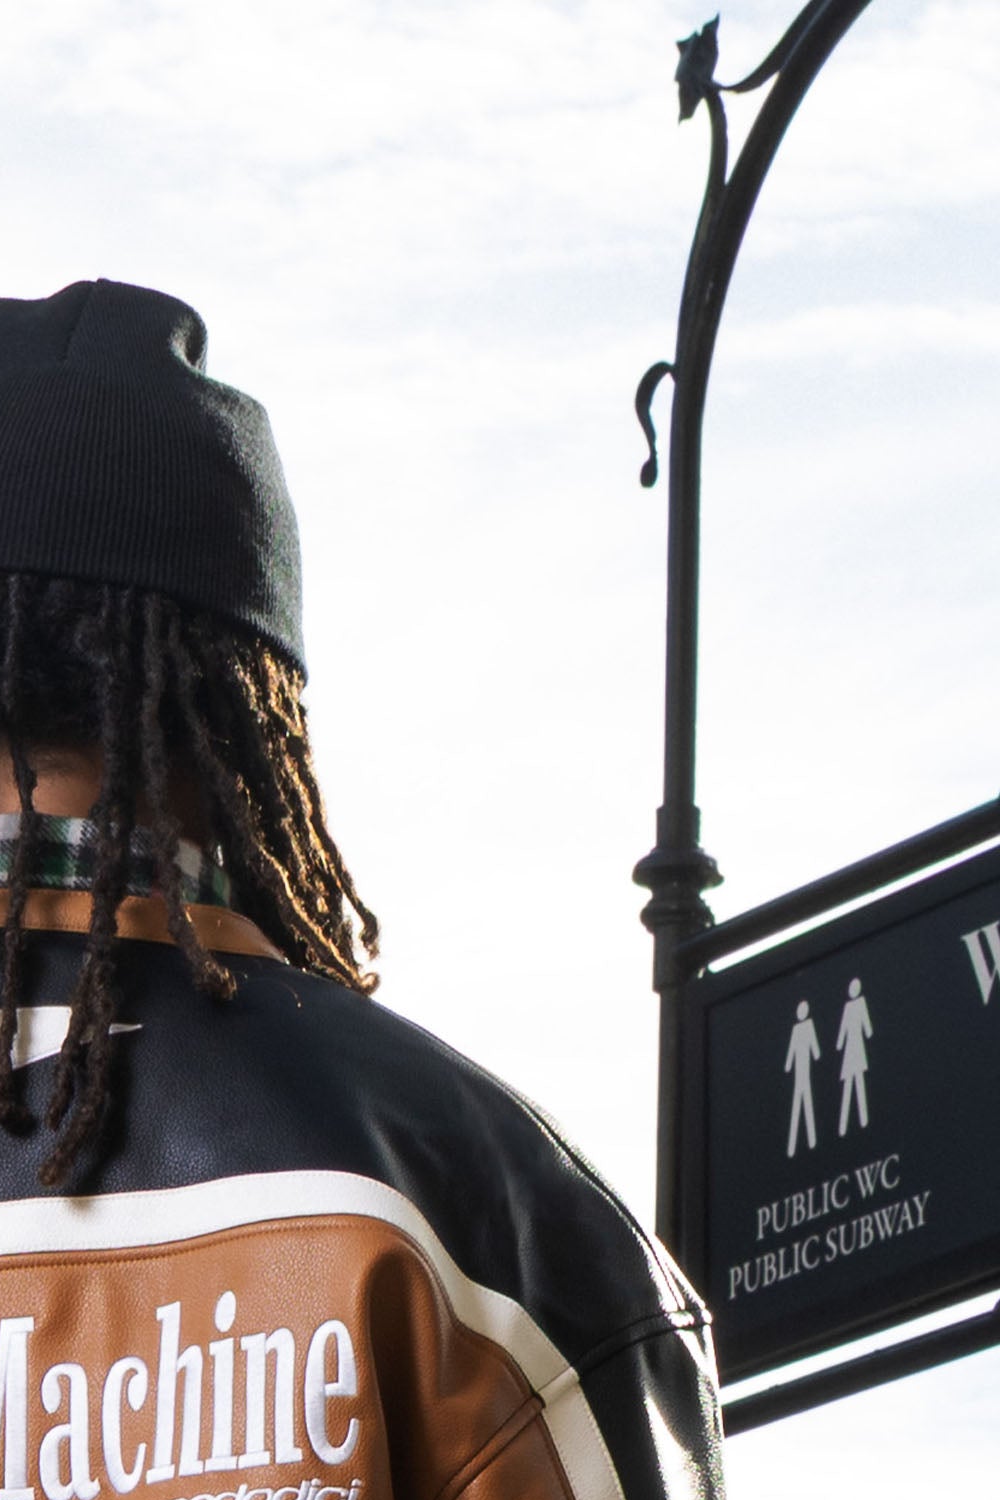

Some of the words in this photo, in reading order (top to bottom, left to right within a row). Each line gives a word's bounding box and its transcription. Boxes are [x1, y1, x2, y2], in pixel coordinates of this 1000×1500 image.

[729, 1235, 820, 1300] PUBLIC
[824, 1190, 931, 1263] SUBWAY
[756, 1174, 849, 1241] PUBLIC
[855, 1153, 900, 1199] WC
